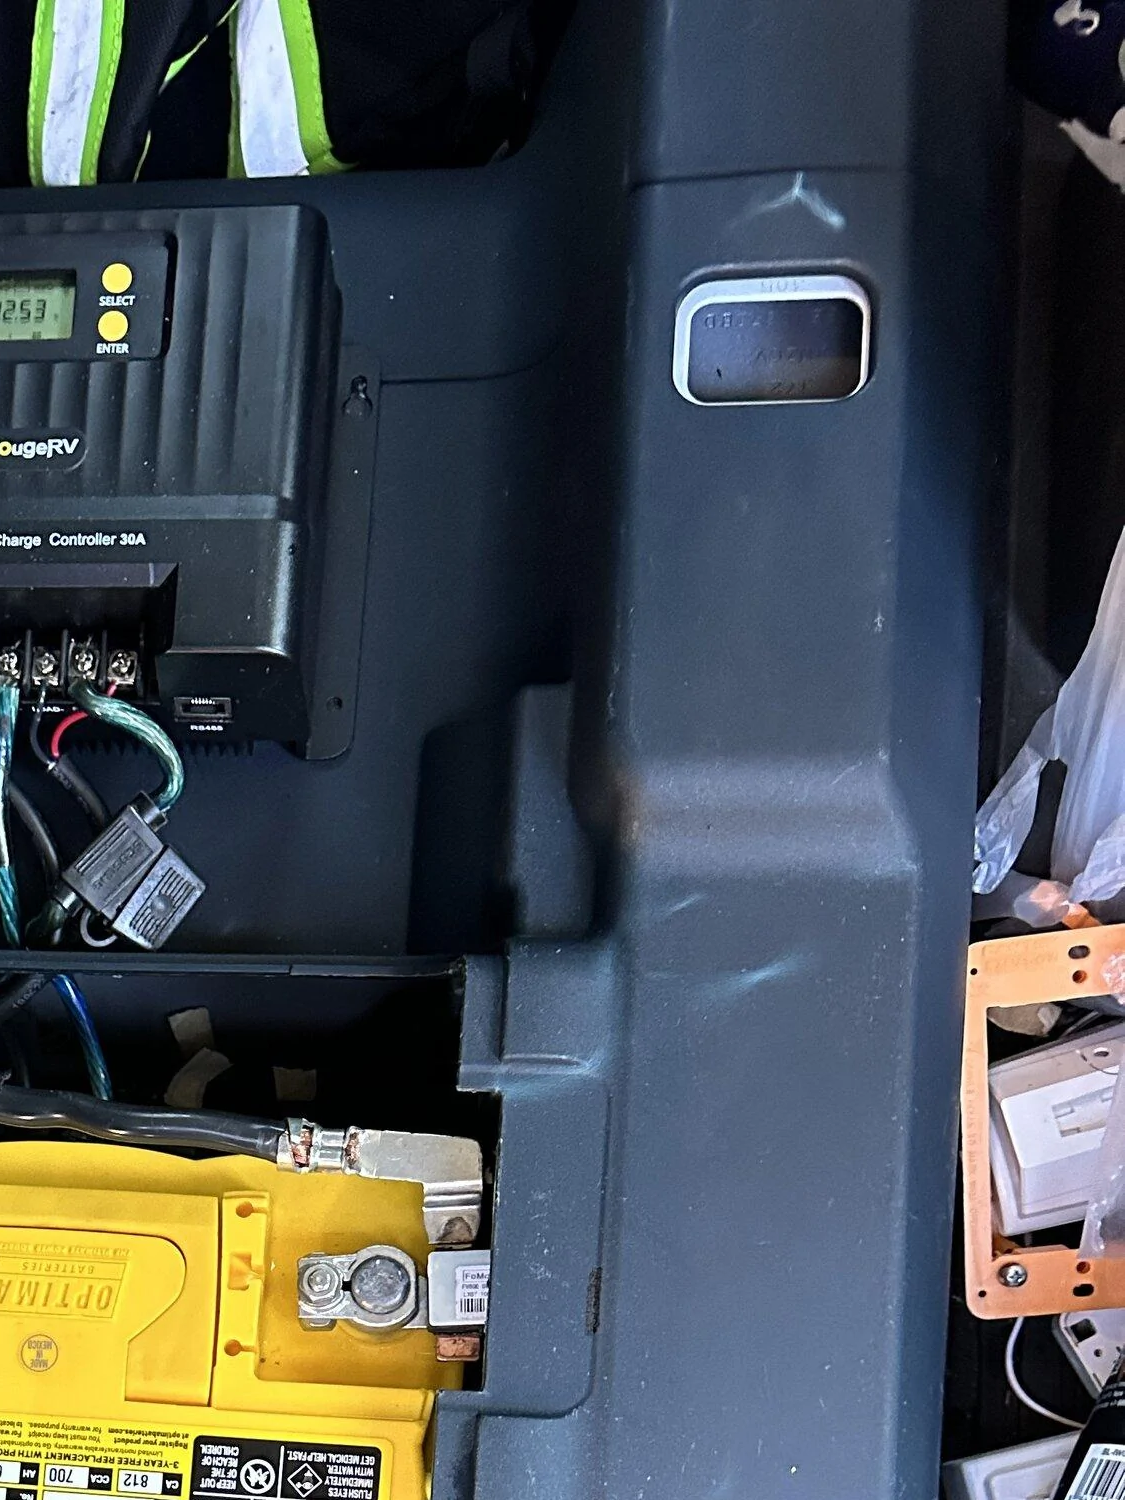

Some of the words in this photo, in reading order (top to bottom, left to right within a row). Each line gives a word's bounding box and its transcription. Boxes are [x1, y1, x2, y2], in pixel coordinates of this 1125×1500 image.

[99, 295, 135, 306] SELECT
[96, 342, 129, 353] ENTER
[49, 532, 116, 546] Controller
[119, 533, 145, 545] 30A
[21, 1260, 94, 1274] BATTERIES
[27, 1340, 52, 1349] MEXICO
[35, 1350, 43, 1358] IN
[29, 1359, 48, 1367] MADE
[60, 1422, 90, 1432] warranty
[107, 1425, 180, 1439] optimabatteries.com
[10, 1429, 21, 1437] For
[28, 1430, 51, 1439] receipt
[52, 1431, 68, 1440] keep
[69, 1433, 86, 1441] must
[113, 1435, 140, 1445] product
[142, 1438, 157, 1446] your
[158, 1439, 187, 1449] Register
[17, 1449, 41, 1458] WITH
[84, 1444, 136, 1455] nontransferable
[137, 1448, 162, 1457] Limited
[199, 1443, 239, 1455] CHILDREN.
[44, 1450, 114, 1464] REPLACEMENT
[201, 1455, 211, 1464] OF
[286, 1450, 306, 1460] FAST.
[306, 1451, 326, 1462] HELP
[327, 1453, 359, 1464] MEDICAL
[359, 1455, 374, 1465] GET
[116, 1456, 140, 1466] FREE
[143, 1458, 178, 1468] 3-YEAR
[212, 1456, 238, 1466] REACH
[22, 1468, 35, 1478] AH
[48, 1467, 73, 1482] 700
[210, 1467, 226, 1477] THE
[226, 1468, 237, 1477] OF
[325, 1464, 353, 1475] WATER.
[353, 1466, 374, 1476] WITH
[89, 1473, 109, 1483] CCA
[123, 1472, 148, 1487] 812
[200, 1477, 215, 1487] OUT
[324, 1475, 373, 1488] IMMEDIATELY
[165, 1479, 178, 1488] CA
[215, 1478, 236, 1489] KEEP
[19, 1492, 33, 1500] No.
[327, 1487, 347, 1497] EYES
[347, 1488, 372, 1499] FLUSH
